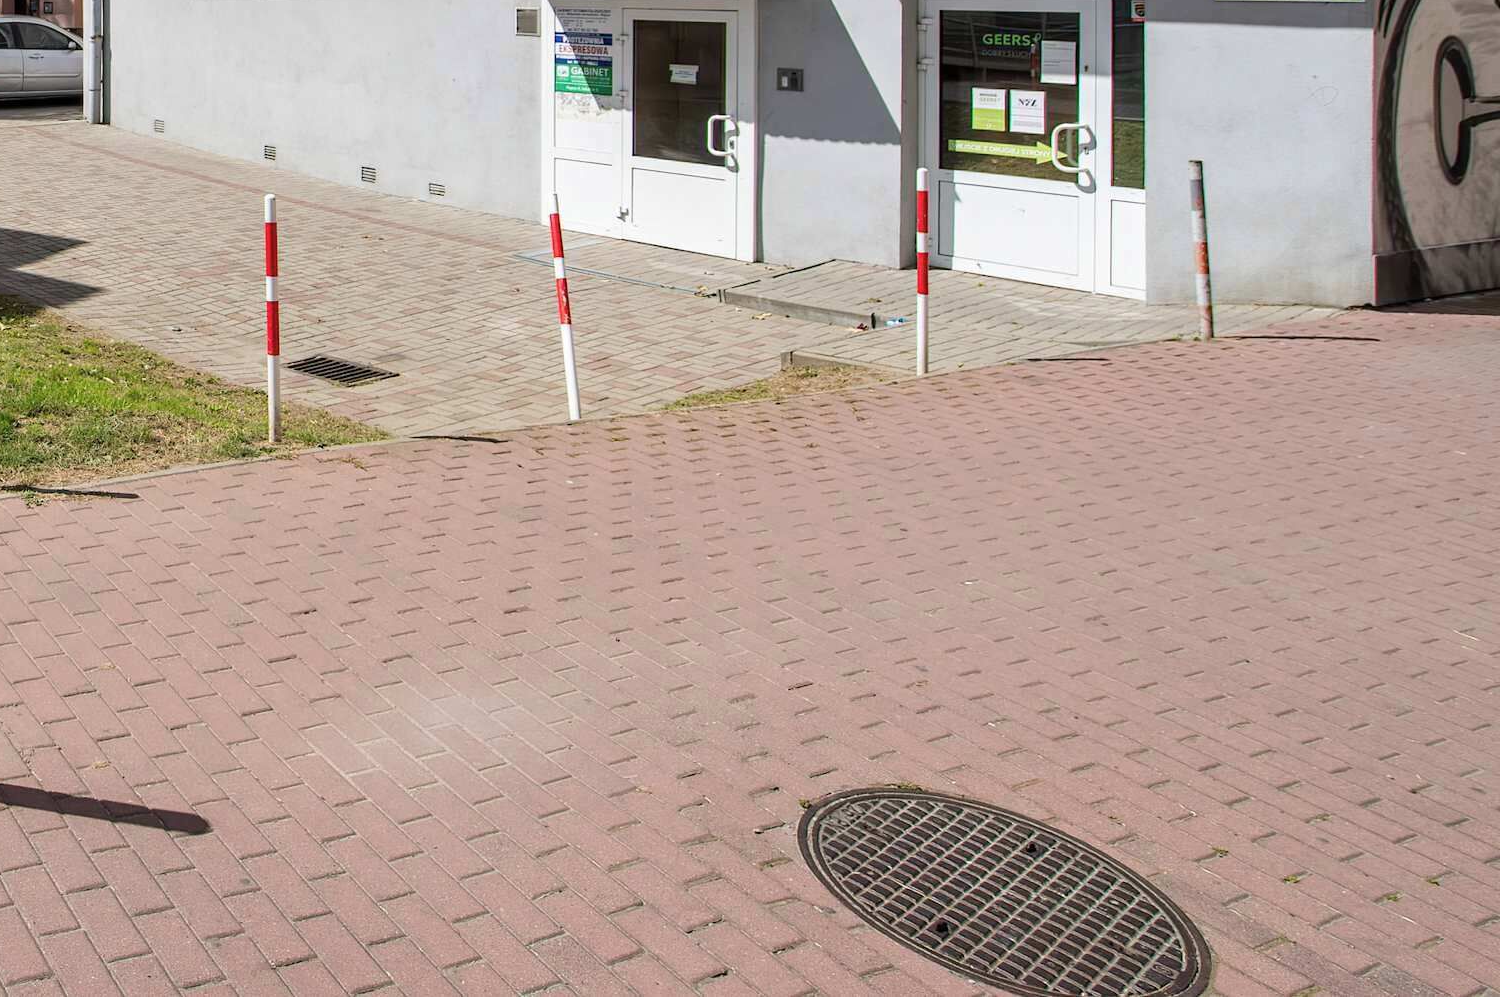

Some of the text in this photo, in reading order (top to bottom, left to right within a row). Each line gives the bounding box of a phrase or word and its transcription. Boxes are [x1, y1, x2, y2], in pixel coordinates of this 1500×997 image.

[982, 33, 1031, 46] GEERS
[558, 45, 609, 55] EKSPRESOWA
[570, 66, 609, 77] GABINET
